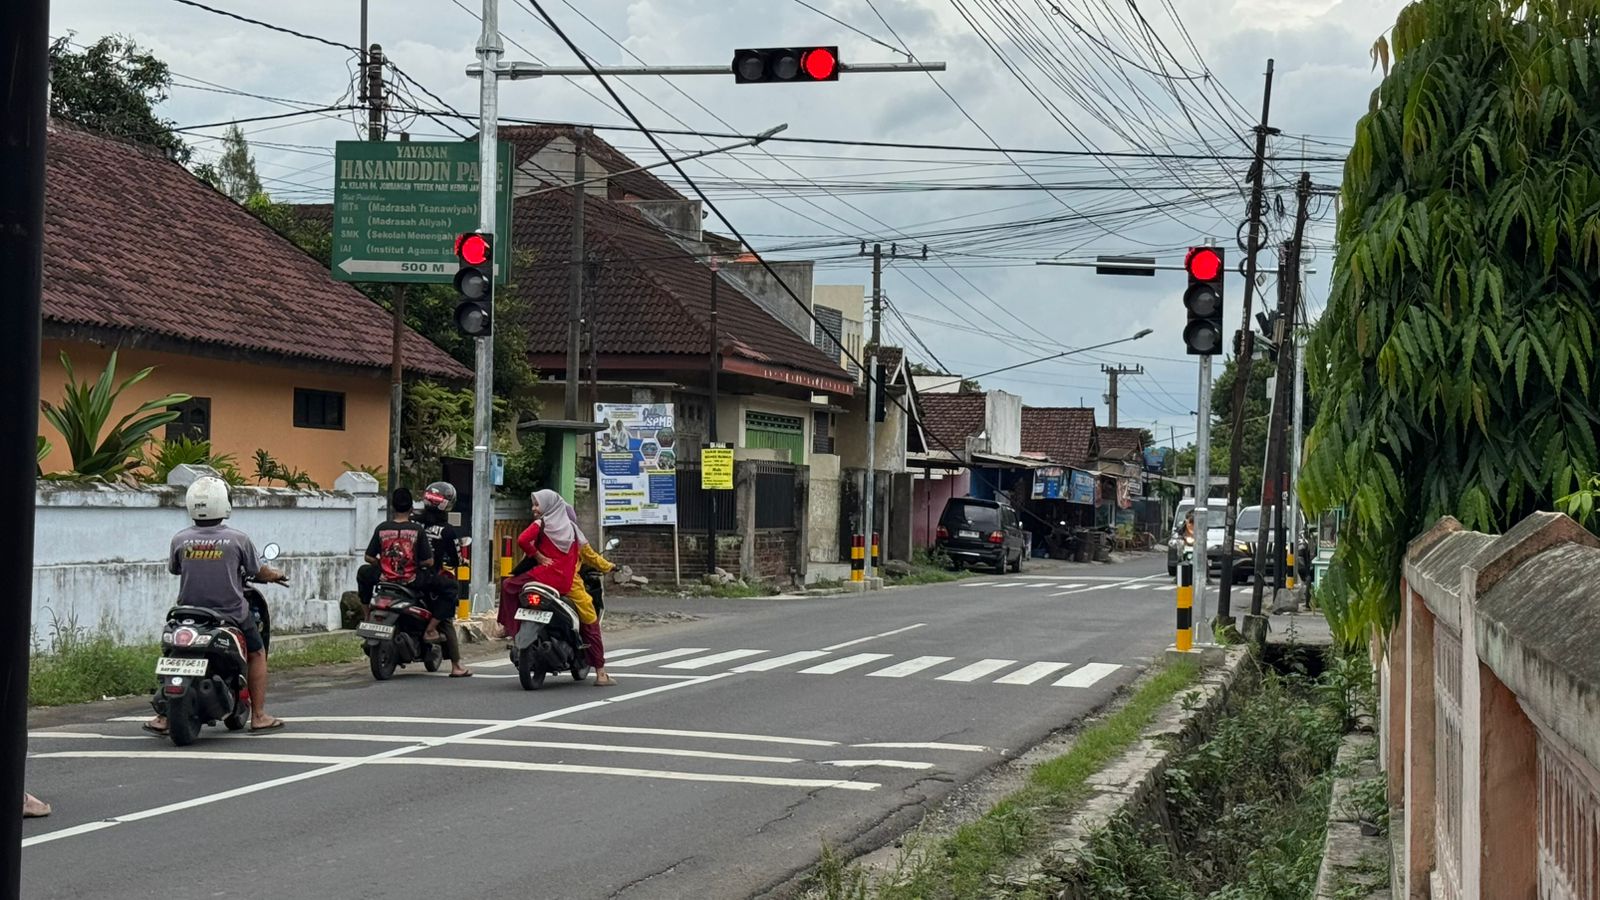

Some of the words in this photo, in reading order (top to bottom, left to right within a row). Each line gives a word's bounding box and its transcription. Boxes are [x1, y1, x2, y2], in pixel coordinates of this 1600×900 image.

[396, 146, 448, 158] YAYASAN
[340, 159, 451, 181] HASANUDDIN
[456, 161, 504, 181] PAE
[368, 201, 417, 212] (Madrasah
[419, 203, 477, 215] Tsanawiyah)
[341, 216, 354, 224] MA
[367, 216, 416, 226] (Madrasah
[418, 218, 452, 228] Aliyah)
[340, 230, 359, 238] SMK
[367, 229, 406, 239] (Sekolah
[407, 231, 453, 241] Menengah
[366, 244, 404, 254] (Institut
[407, 247, 441, 256] Agama
[401, 263, 428, 272] 500
[432, 264, 445, 272] M
[646, 416, 673, 428] SPMB
[183, 550, 224, 559] LIBUR
